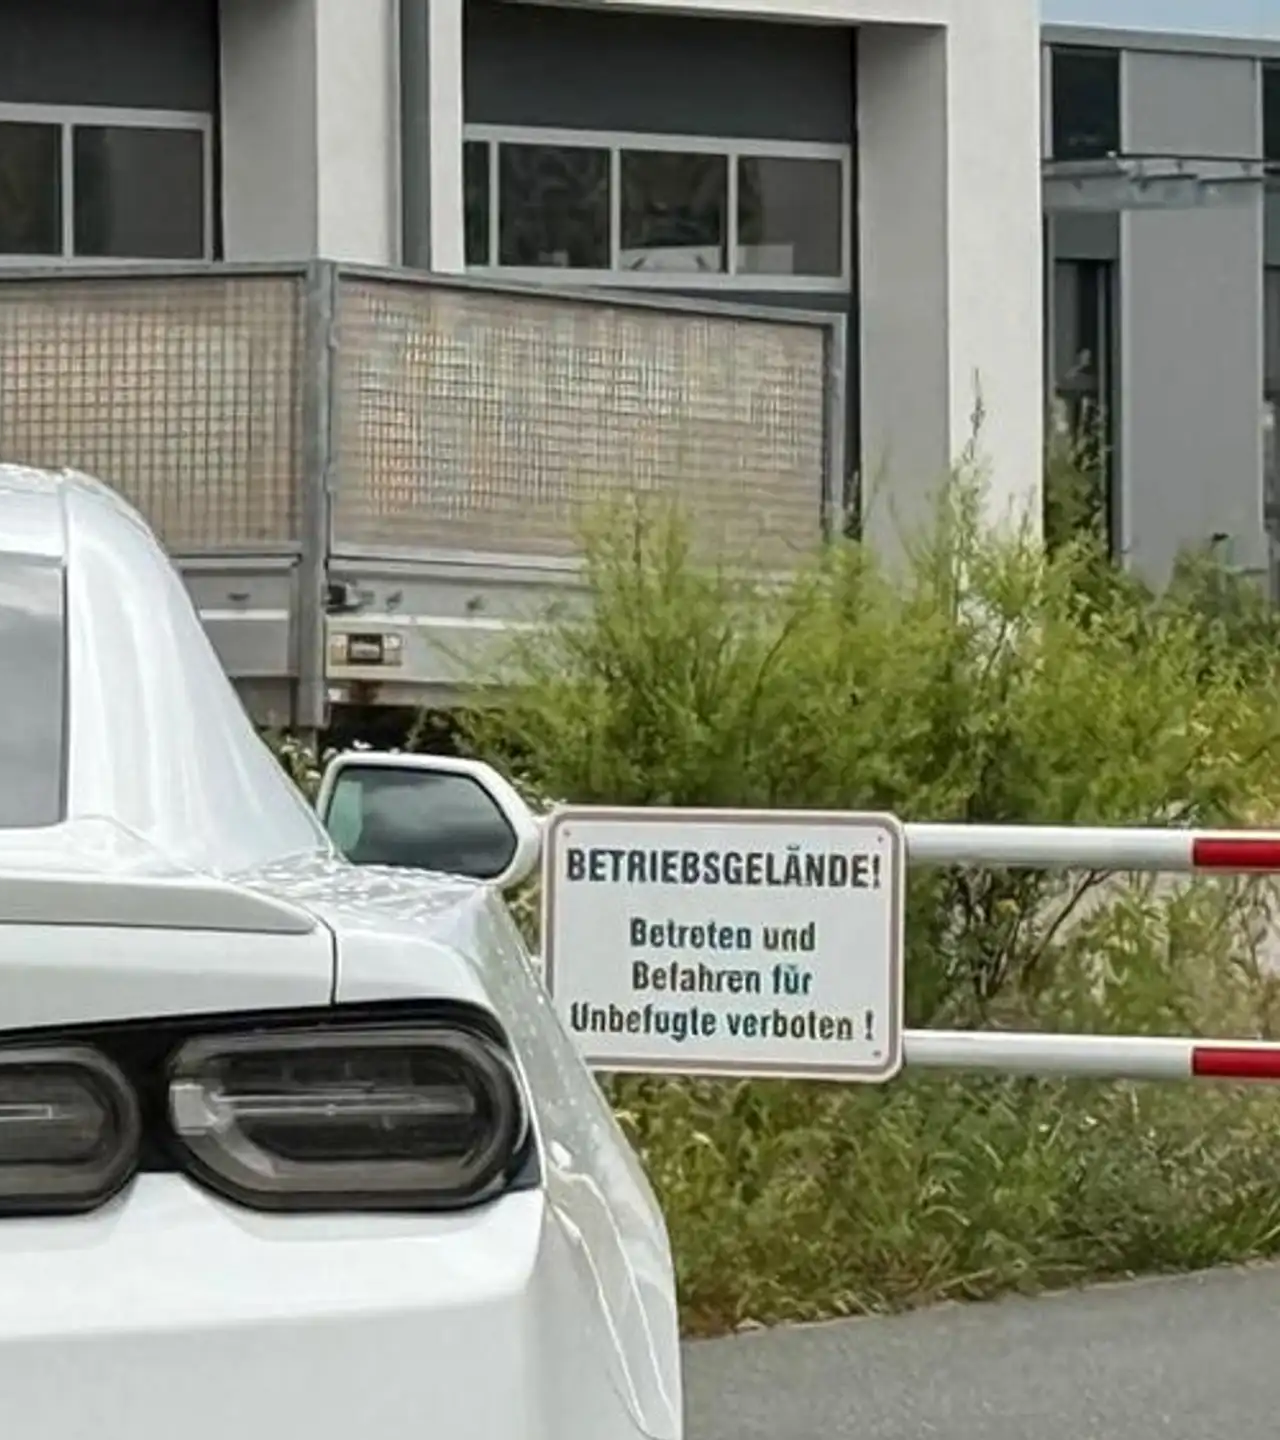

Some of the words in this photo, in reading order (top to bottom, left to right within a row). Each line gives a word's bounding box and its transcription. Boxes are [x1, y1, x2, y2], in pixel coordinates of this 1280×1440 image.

[566, 845, 881, 889] BETRIEBSGELÄNDE!
[629, 917, 753, 951] Betreten
[762, 920, 818, 952] und
[631, 960, 762, 994] Befahren
[772, 963, 814, 996] für
[570, 1001, 717, 1043] Unbefugte
[726, 1008, 854, 1042] verboten
